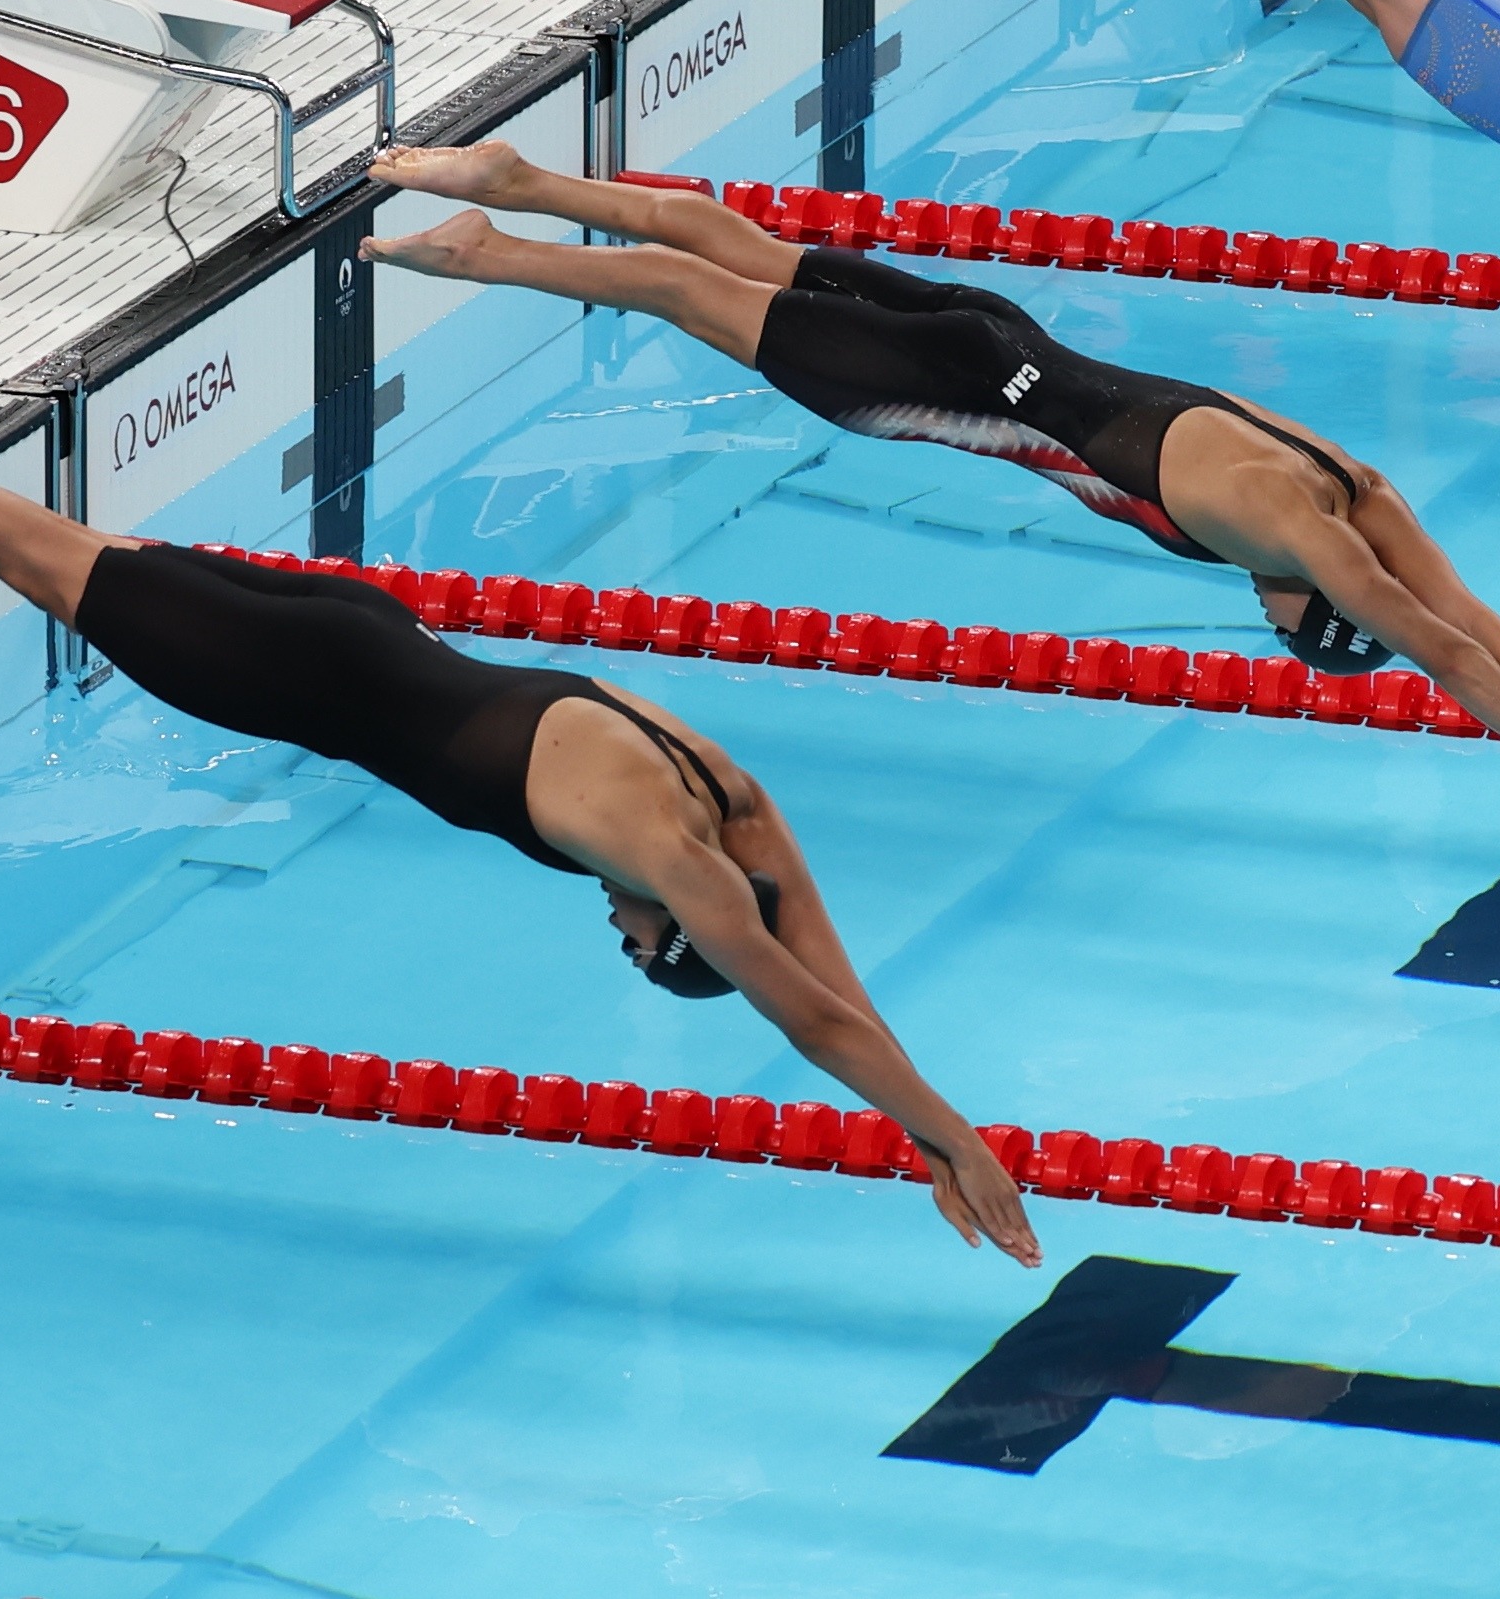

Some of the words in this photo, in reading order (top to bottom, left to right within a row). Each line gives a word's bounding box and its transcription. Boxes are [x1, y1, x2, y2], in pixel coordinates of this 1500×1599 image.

[667, 10, 747, 99] OMEGA
[145, 350, 235, 448] OMEGA
[1001, 362, 1041, 405] CAN
[1348, 627, 1373, 655] AN
[664, 930, 689, 965] RINI
